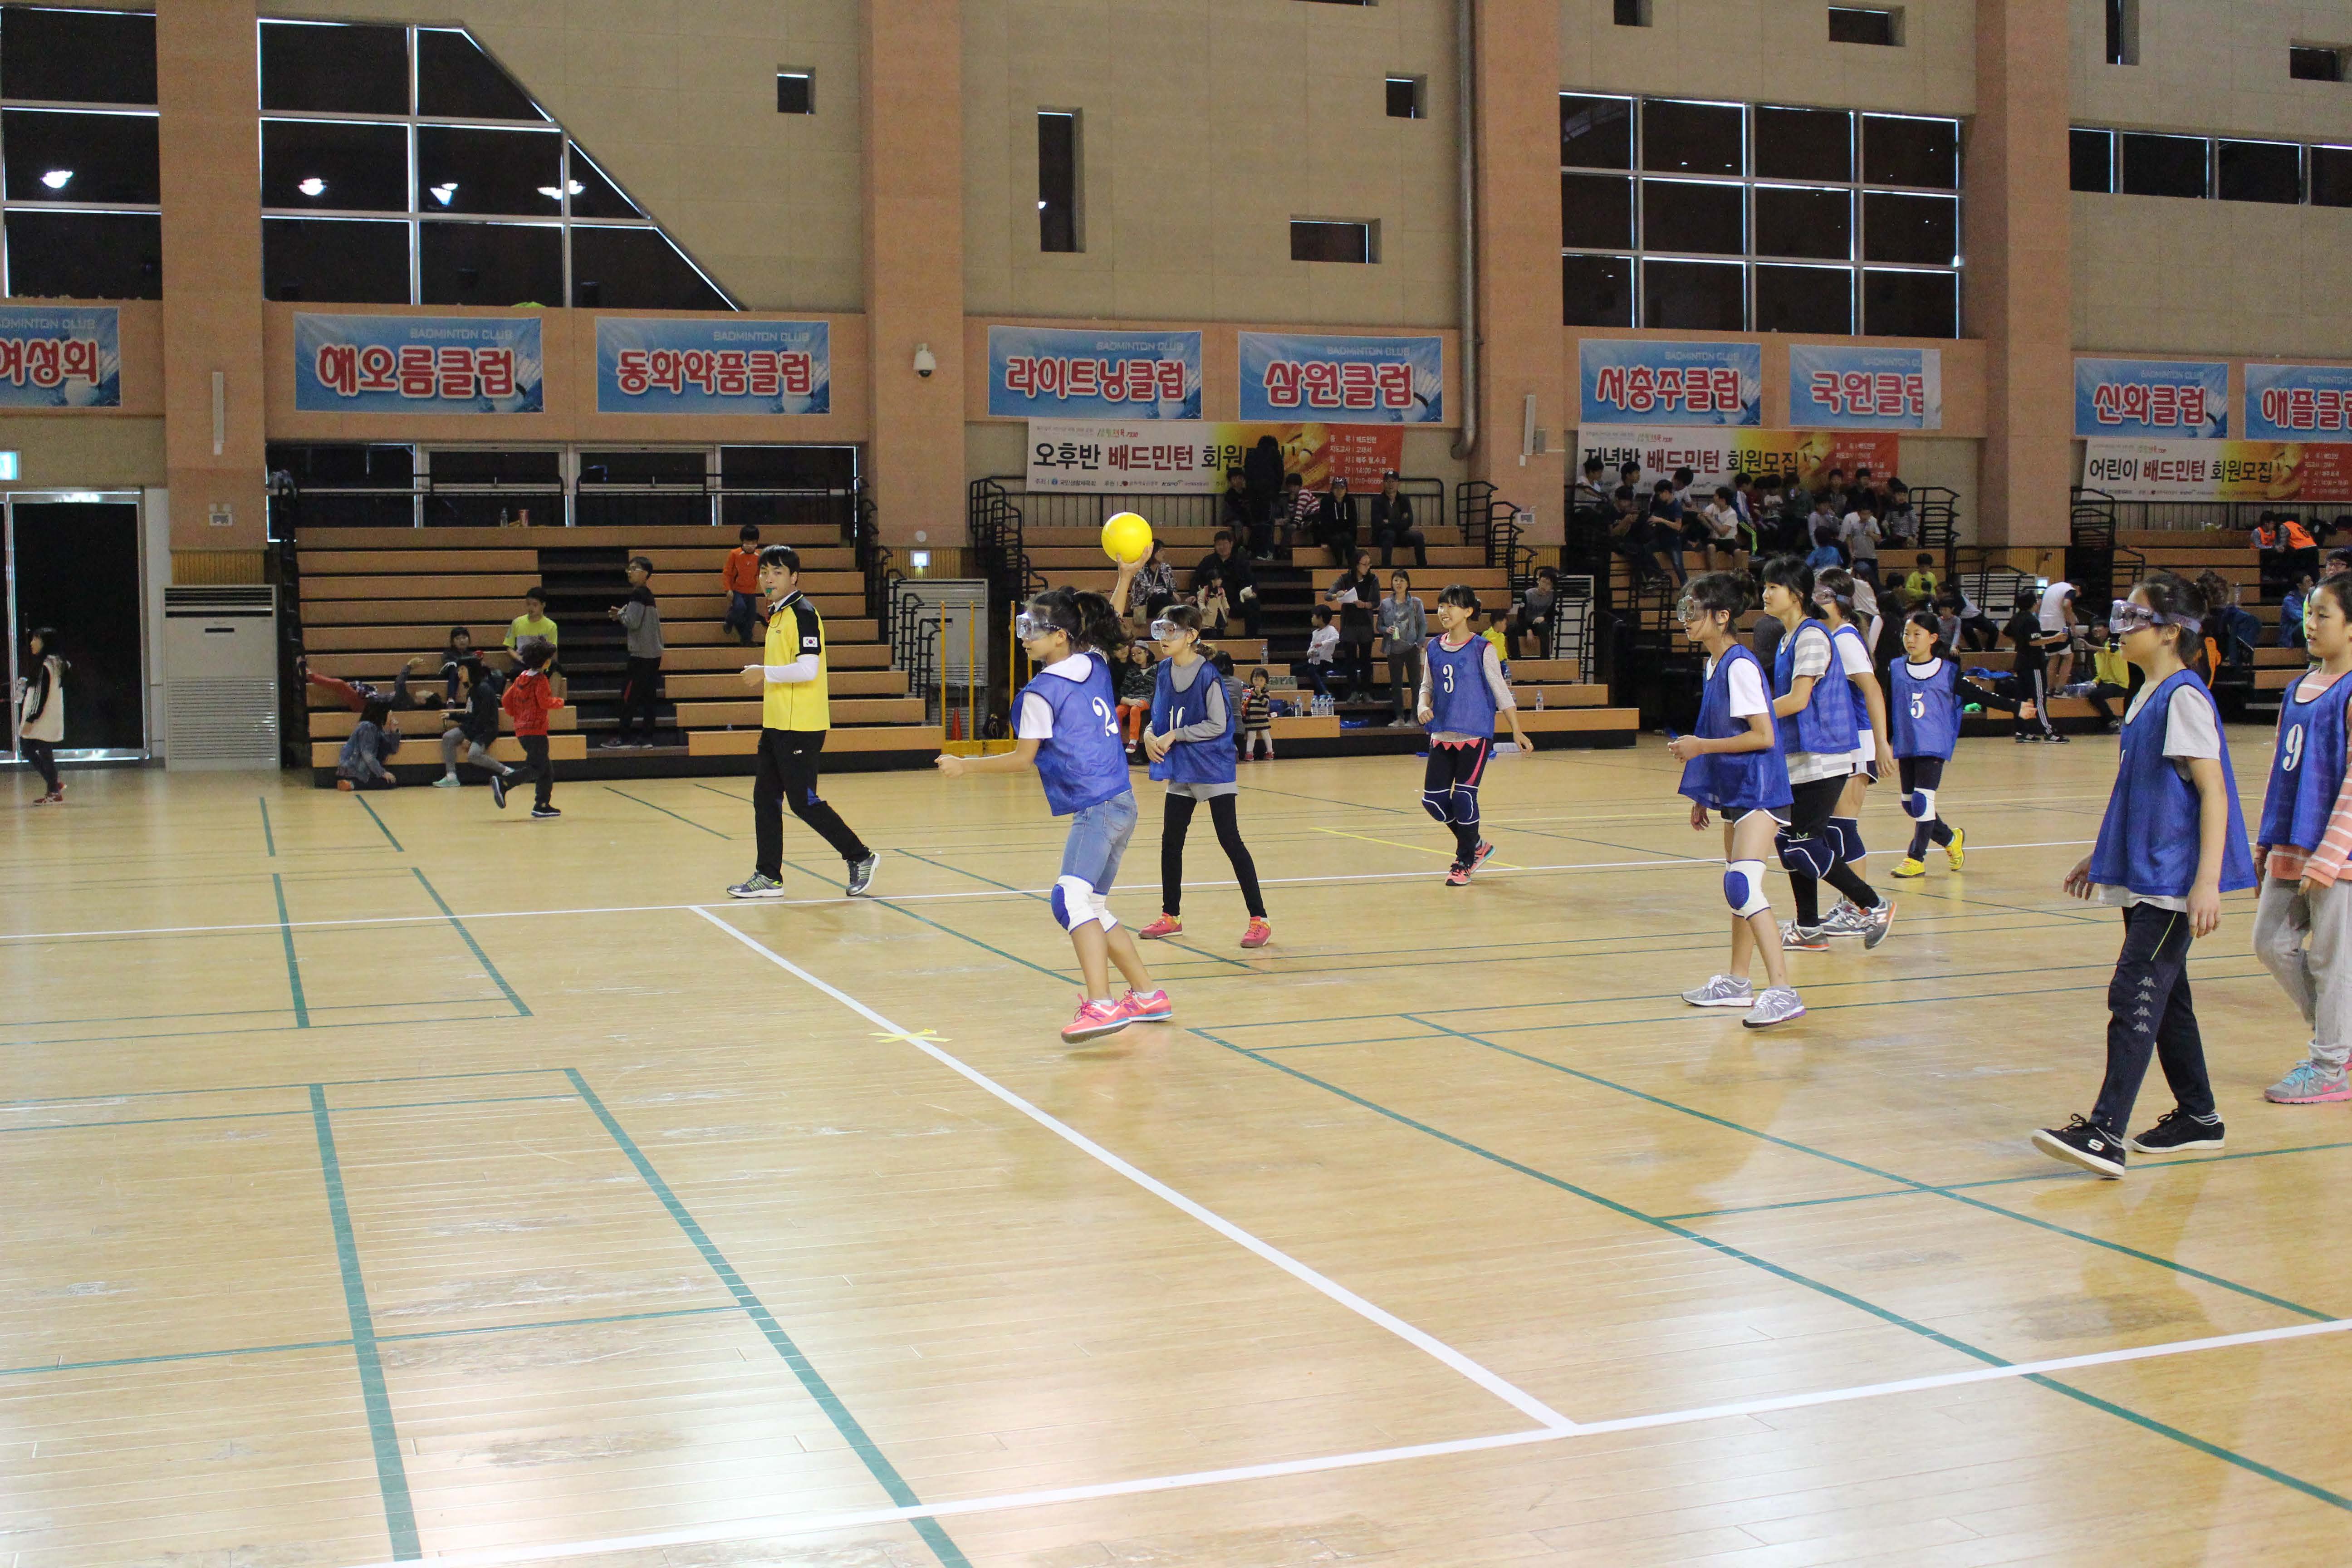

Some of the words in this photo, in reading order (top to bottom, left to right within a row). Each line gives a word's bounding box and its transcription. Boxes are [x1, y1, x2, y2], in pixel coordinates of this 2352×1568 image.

[410, 328, 478, 339] BADMINTON
[482, 329, 513, 340] CLUB
[713, 331, 777, 342] BADMINTON
[780, 332, 809, 342] CLUB
[1096, 341, 1155, 351] BADMINTON
[1158, 342, 1184, 351] CLUB
[1327, 346, 1382, 356] BADMINTON
[1386, 347, 1410, 356] CLUB
[1665, 351, 1714, 361] BADMINTON
[1717, 352, 1739, 362] CLUB
[616, 348, 812, 396] 동화약품클럽
[1006, 356, 1186, 402] 라이트닝클럽
[1263, 360, 1414, 408] 삼원클럽
[1596, 364, 1742, 412] 서충주클럽
[2093, 382, 2207, 427] 신화클럽
[1034, 442, 1101, 470] 오후반
[1108, 444, 1193, 471] 배드민턴
[1201, 445, 1284, 472] 회원
[1647, 449, 1720, 474] 배드민턴
[1726, 449, 1799, 475] 회원모집
[2089, 458, 2138, 481] 어린이
[2143, 459, 2206, 482] 배드민턴
[2210, 461, 2273, 484] 회원모집
[1443, 664, 1454, 694] 3
[1092, 696, 1119, 737] 2
[1911, 691, 1925, 719] 5
[2282, 723, 2303, 771] 9
